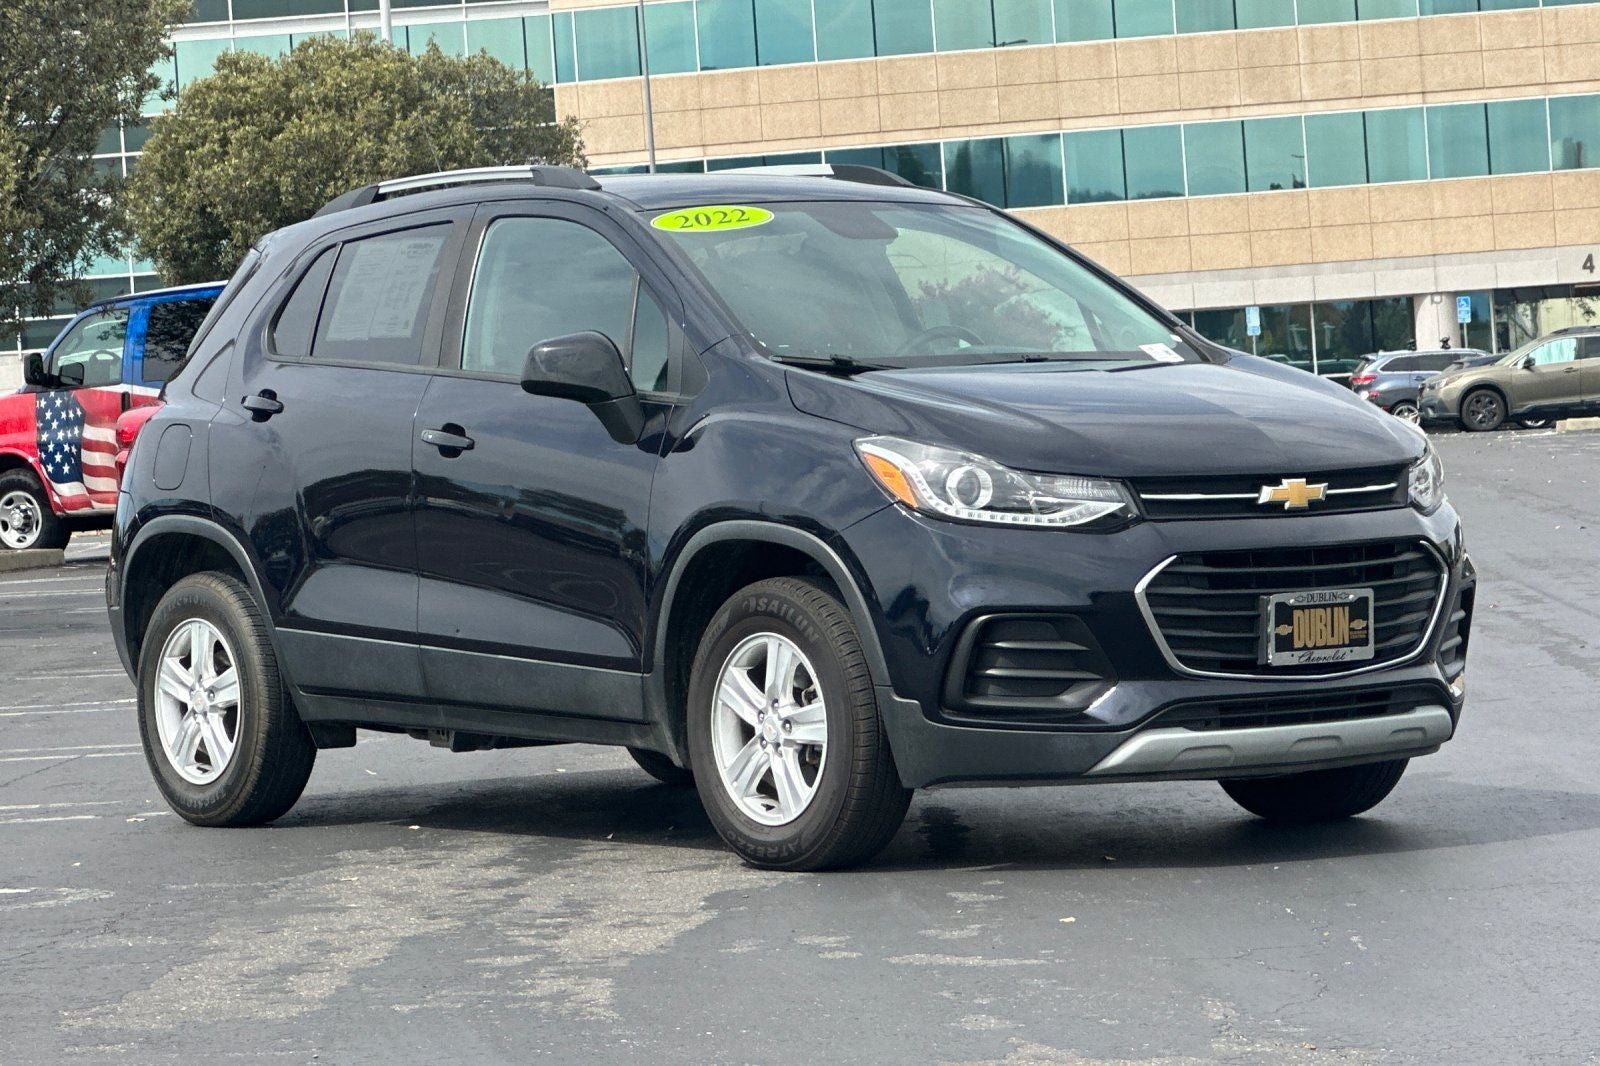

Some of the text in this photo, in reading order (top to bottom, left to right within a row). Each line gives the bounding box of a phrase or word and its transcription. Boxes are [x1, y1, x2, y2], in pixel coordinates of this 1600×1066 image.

[674, 208, 750, 228] 2022
[1582, 253, 1595, 273] 4
[1306, 591, 1338, 603] DUBLIN
[1293, 605, 1349, 648] DUBLIN
[1297, 650, 1347, 663] Chevrolet
